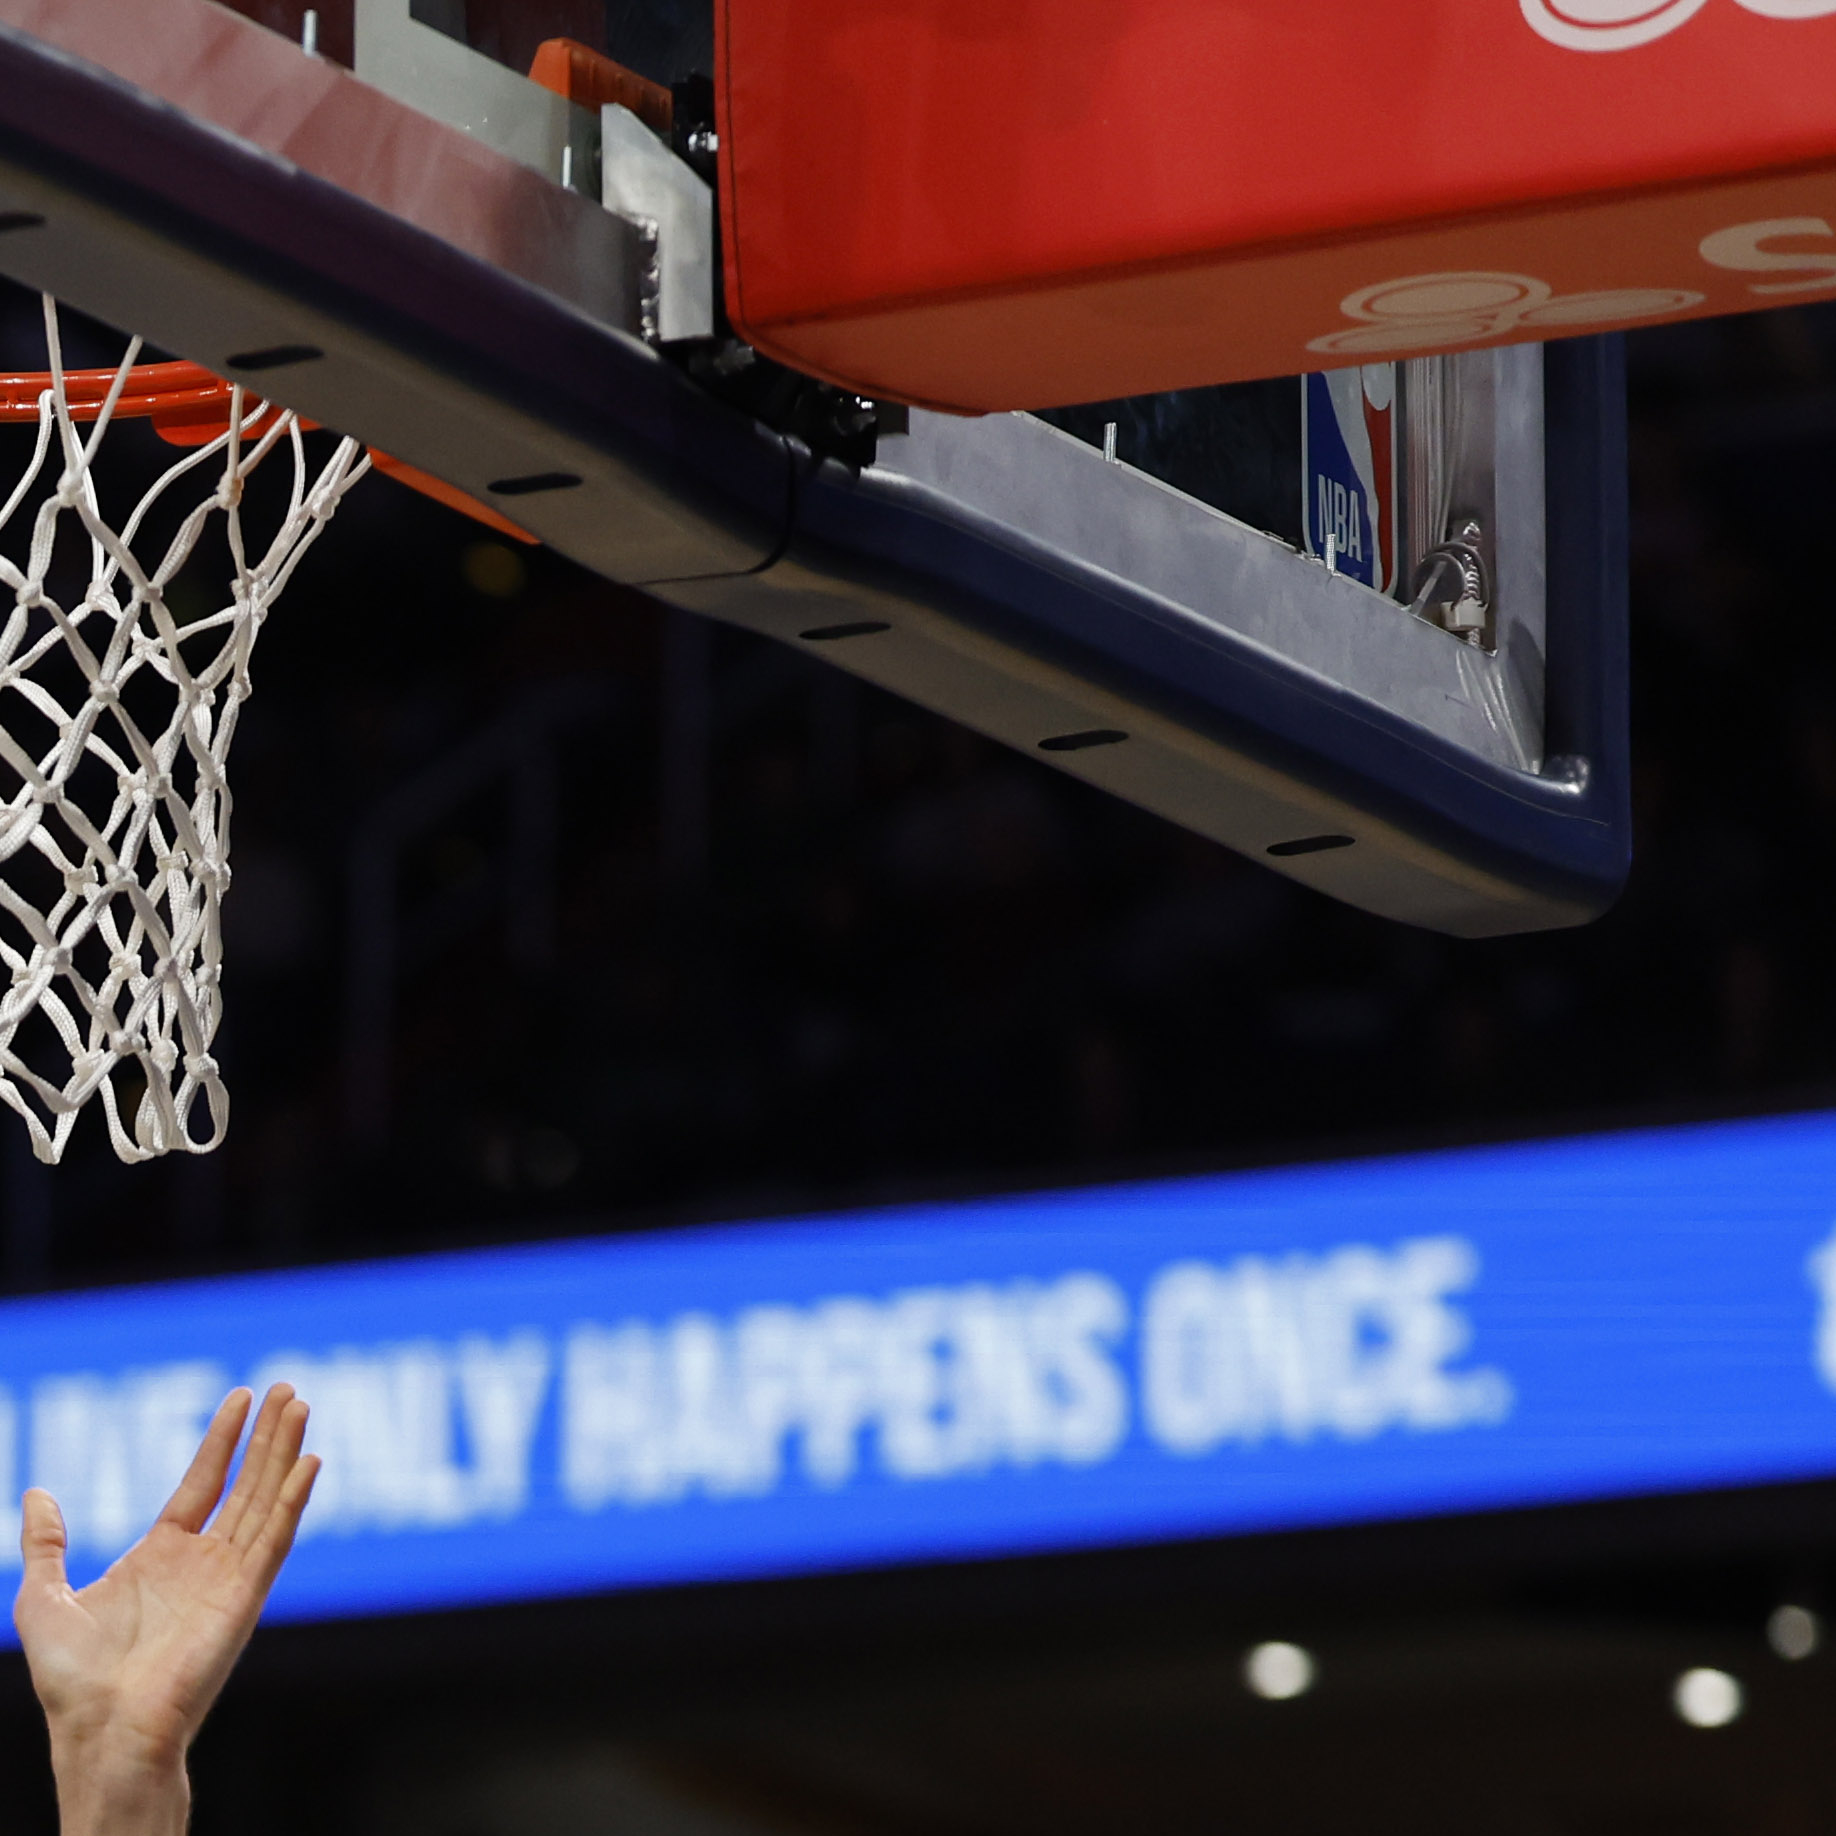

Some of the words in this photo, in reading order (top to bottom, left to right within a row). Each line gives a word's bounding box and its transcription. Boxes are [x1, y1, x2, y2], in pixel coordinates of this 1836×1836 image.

[1318, 473, 1362, 563] NBA
[561, 1268, 1129, 1512] HAPPENS
[1141, 1233, 1517, 1459] ONCE.
